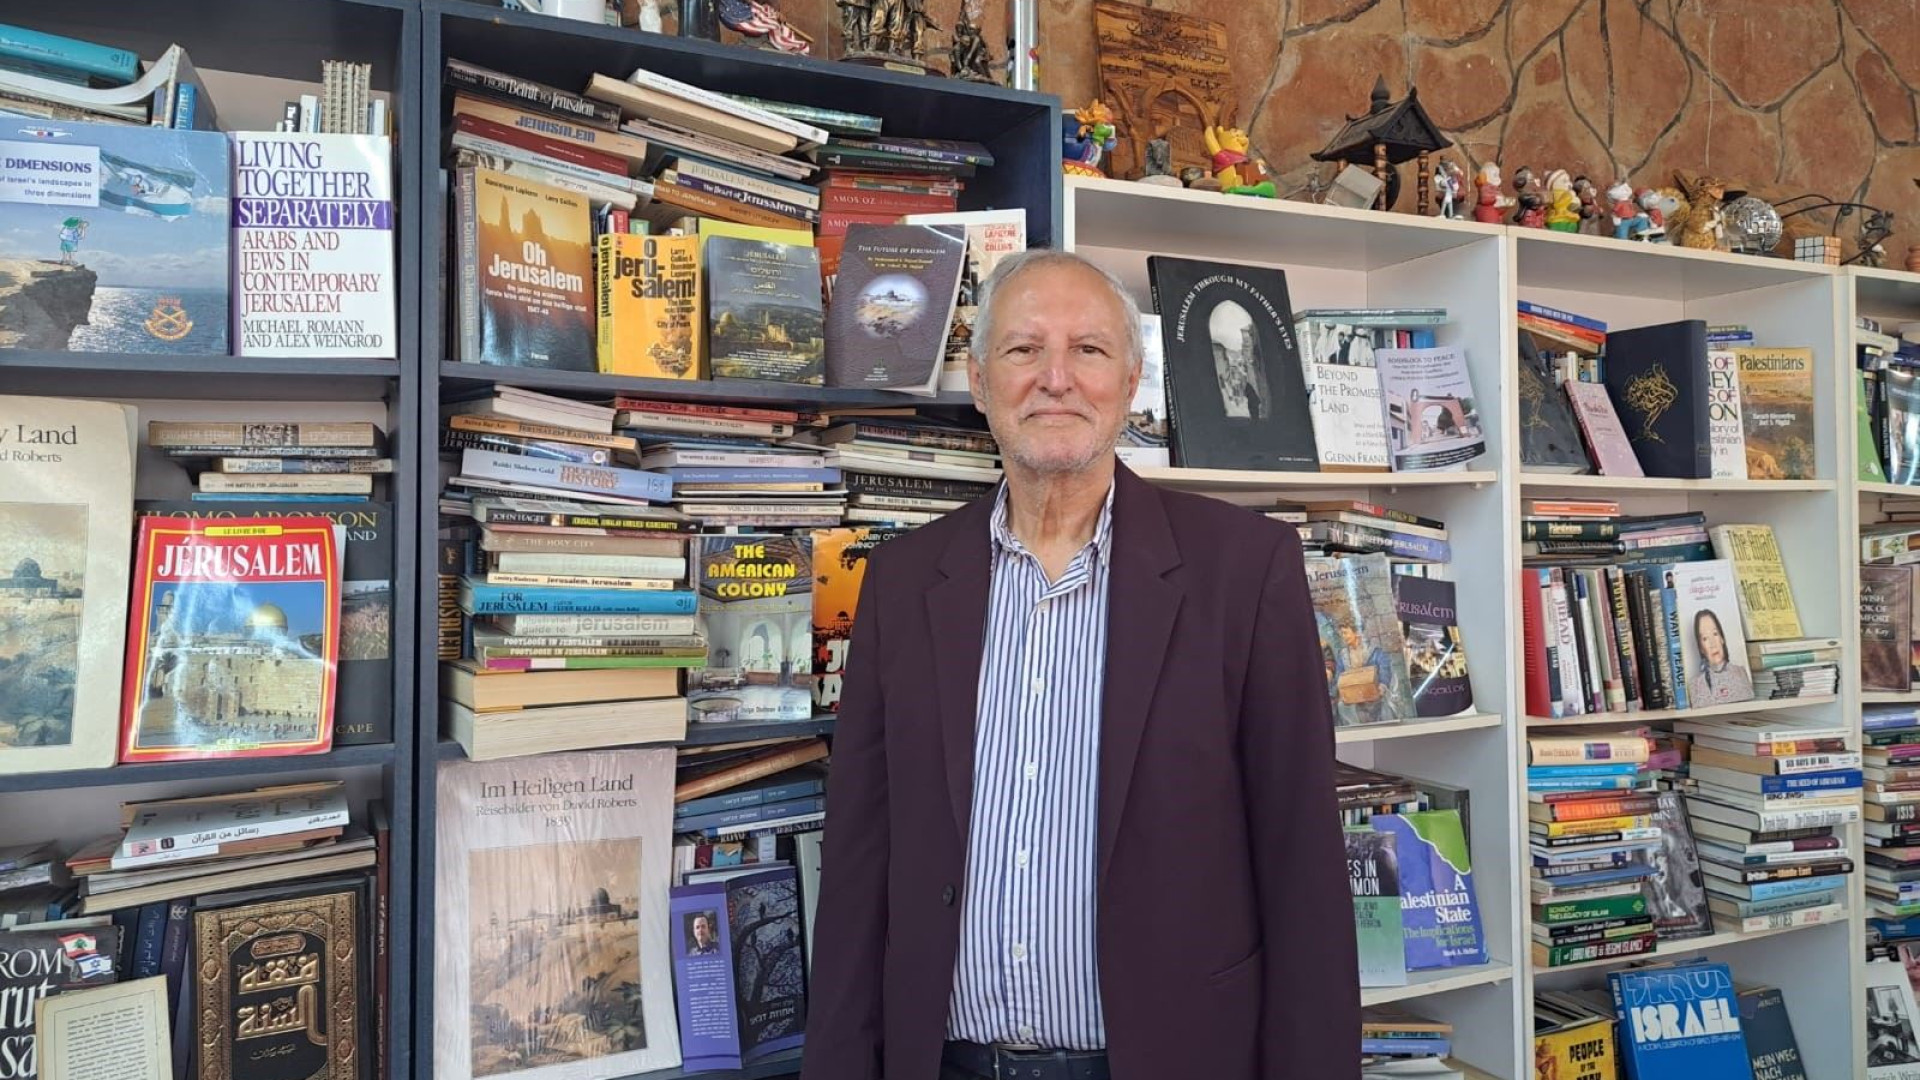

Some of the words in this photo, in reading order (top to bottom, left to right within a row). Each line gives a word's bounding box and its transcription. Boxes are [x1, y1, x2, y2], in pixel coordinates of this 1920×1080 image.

[508, 78, 540, 102] Beirut
[551, 91, 595, 118] Jerusalem
[515, 115, 596, 143] JERUSALEM
[239, 141, 322, 169] LIVING
[6, 157, 92, 173] DIMENSIONS
[239, 169, 373, 198] TOGETHER
[739, 191, 797, 215] Jerusalem
[833, 195, 860, 205] AMOS
[862, 196, 877, 206] OZ
[239, 198, 380, 228] SEPARATELY
[243, 231, 297, 250] ARABS
[302, 232, 340, 251] AND
[522, 240, 547, 266] Oh
[241, 252, 286, 275] JEWS
[291, 252, 310, 271] IN
[614, 250, 665, 280] jeru-
[488, 253, 583, 293] Jerusalem
[243, 272, 381, 293] CONTEMPORARY
[631, 271, 696, 299] salem!
[242, 294, 342, 317] JERUSALEM
[1176, 291, 1196, 343] JERUSALEM
[1194, 275, 1234, 292] THROUGH
[1235, 278, 1250, 290] MY
[1250, 287, 1283, 326] FATHER'S
[1279, 326, 1293, 350] EYES
[243, 320, 302, 334] MICHAEL
[307, 320, 365, 335] ROMANN
[243, 335, 272, 348] AND
[275, 335, 311, 348] ALEX
[314, 335, 383, 349] WEINGROD
[1714, 356, 1734, 370] OF
[1740, 354, 1805, 371] Palestinians
[1317, 366, 1358, 381] BEYOND
[1319, 385, 1338, 396] THE
[1340, 383, 1383, 398] PROMISE
[1717, 389, 1737, 403] OF
[1320, 401, 1350, 414] LAND
[16, 424, 78, 445] Land
[519, 424, 567, 437] JERUSALEM
[12, 449, 62, 463] Roberts
[1324, 451, 1356, 463] GLENN
[493, 461, 512, 469] Rabbi
[538, 466, 555, 475] Gold
[559, 473, 616, 490] HISTORY
[853, 475, 932, 490] JERUSALEM
[492, 511, 516, 521] JOHN
[546, 538, 571, 547] HOLY
[574, 540, 594, 548] CITY
[733, 543, 765, 559] THE
[1727, 529, 1751, 560] The
[1749, 529, 1779, 561] Road
[157, 537, 322, 577] JÉRUSALEM
[707, 563, 797, 579] AMERICAN
[1313, 563, 1370, 583] Jerusalem
[590, 577, 632, 588] Jerusalem
[716, 582, 788, 597] COLONY
[501, 592, 523, 602] FOR
[1740, 580, 1764, 611] Not
[1763, 580, 1795, 611] Taken
[478, 601, 548, 612] JERUSALEM
[522, 625, 552, 635] guide
[575, 614, 670, 633] jerusalem
[1668, 610, 1680, 639] WAR
[558, 638, 602, 647] JERUSALEM
[480, 781, 506, 799] Im
[512, 777, 585, 798] Heiligen
[590, 773, 634, 792] Land
[476, 803, 536, 816] Reisebilder
[539, 802, 560, 812] von
[563, 798, 595, 811] David
[597, 798, 637, 809] Roberts
[1896, 805, 1915, 820] ISIS
[218, 830, 233, 841] من
[234, 827, 260, 839] رسائل
[1364, 859, 1377, 877] IN
[1454, 874, 1467, 891] A
[1401, 889, 1470, 909] alestinian
[1435, 906, 1472, 923] State
[1403, 927, 1421, 938] The
[1421, 925, 1475, 937] Implications
[1631, 998, 1741, 1043] ISRAEL
[1569, 1038, 1605, 1063] PEOPLE
[1752, 1054, 1776, 1069] MEIN
[1774, 1049, 1797, 1063] WEG
[1755, 1066, 1783, 1080] NACH
